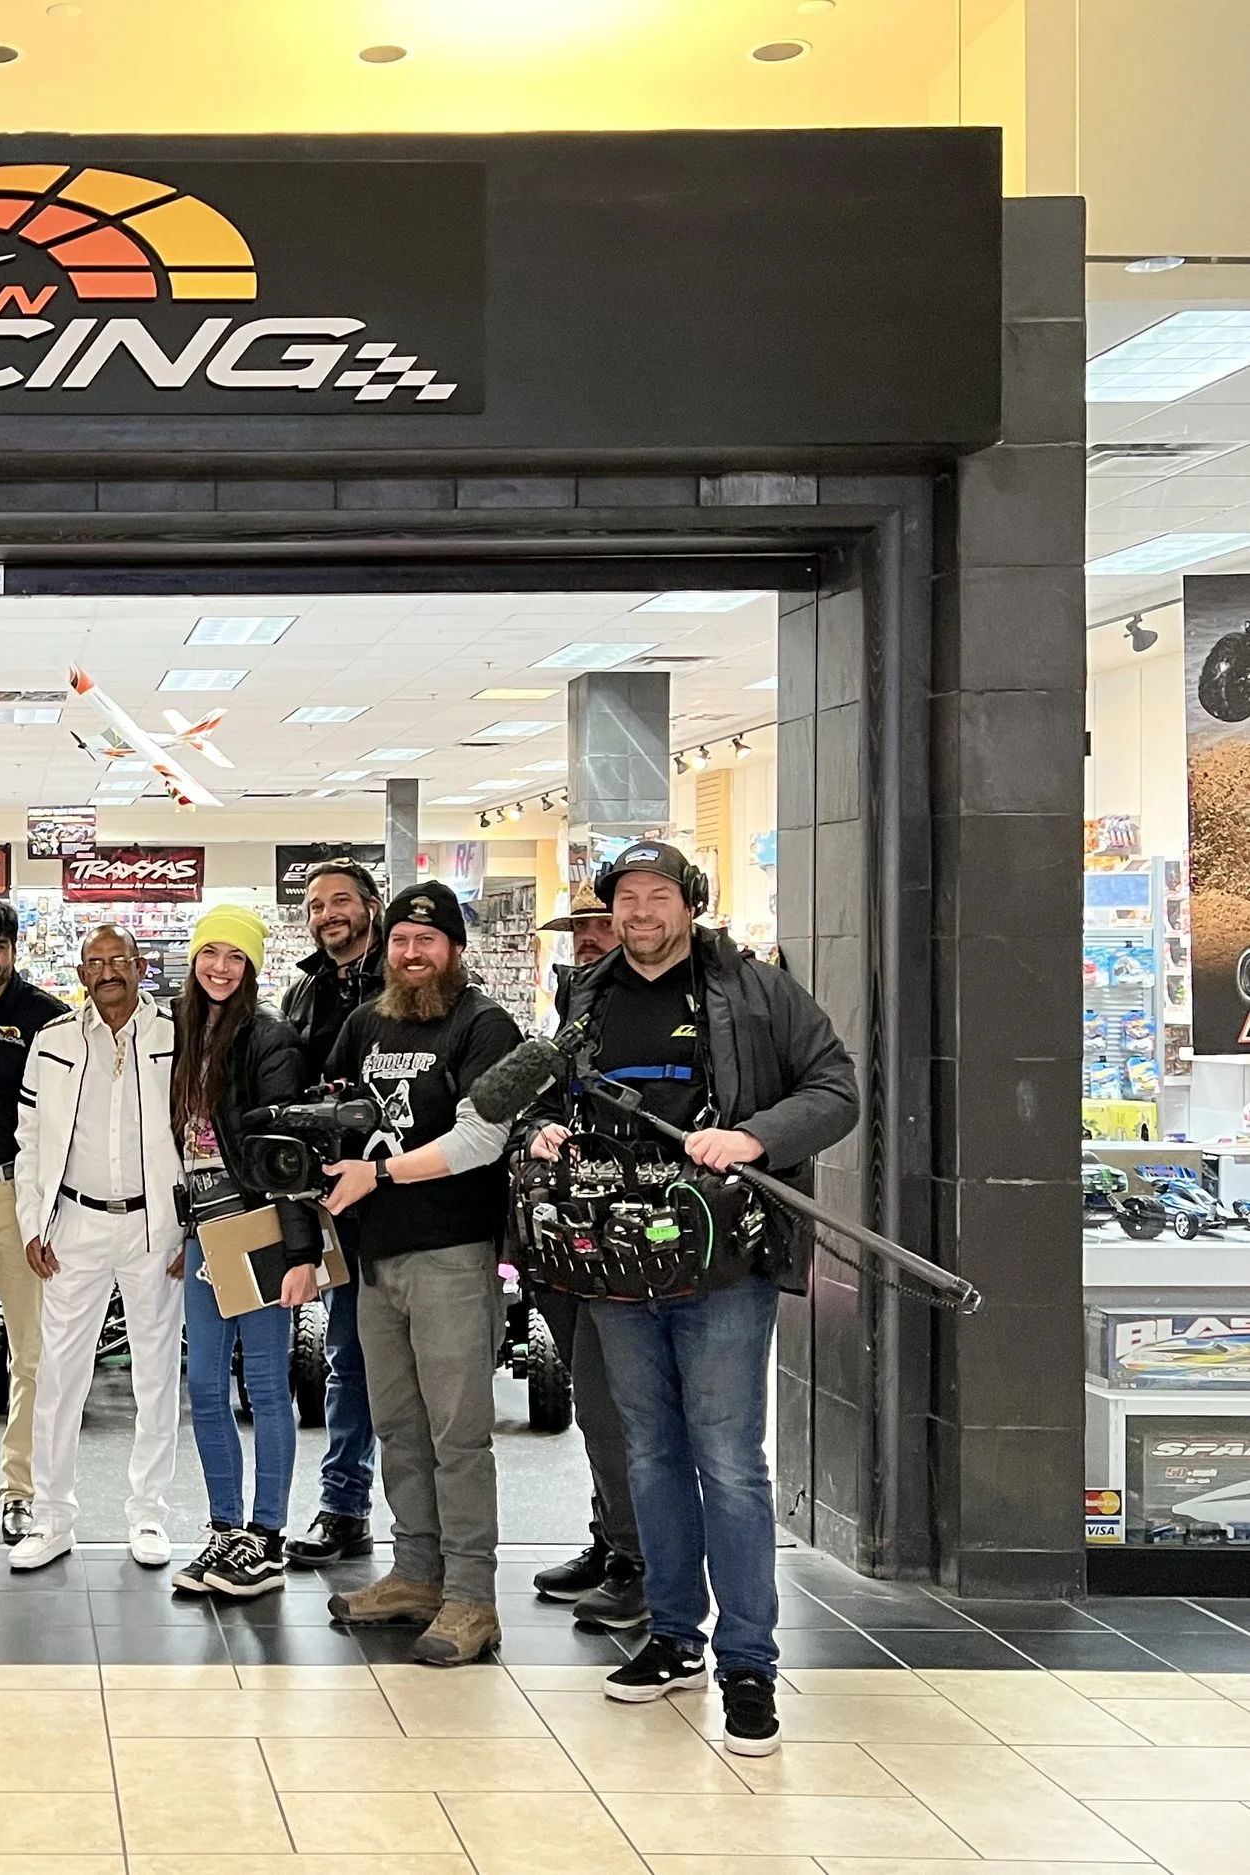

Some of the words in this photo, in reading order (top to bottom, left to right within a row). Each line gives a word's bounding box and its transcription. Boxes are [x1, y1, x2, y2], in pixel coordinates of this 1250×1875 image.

[70, 860, 197, 880] TRAXXAS
[1151, 1442, 1250, 1456] SPA
[1087, 1526, 1115, 1536] VISA
